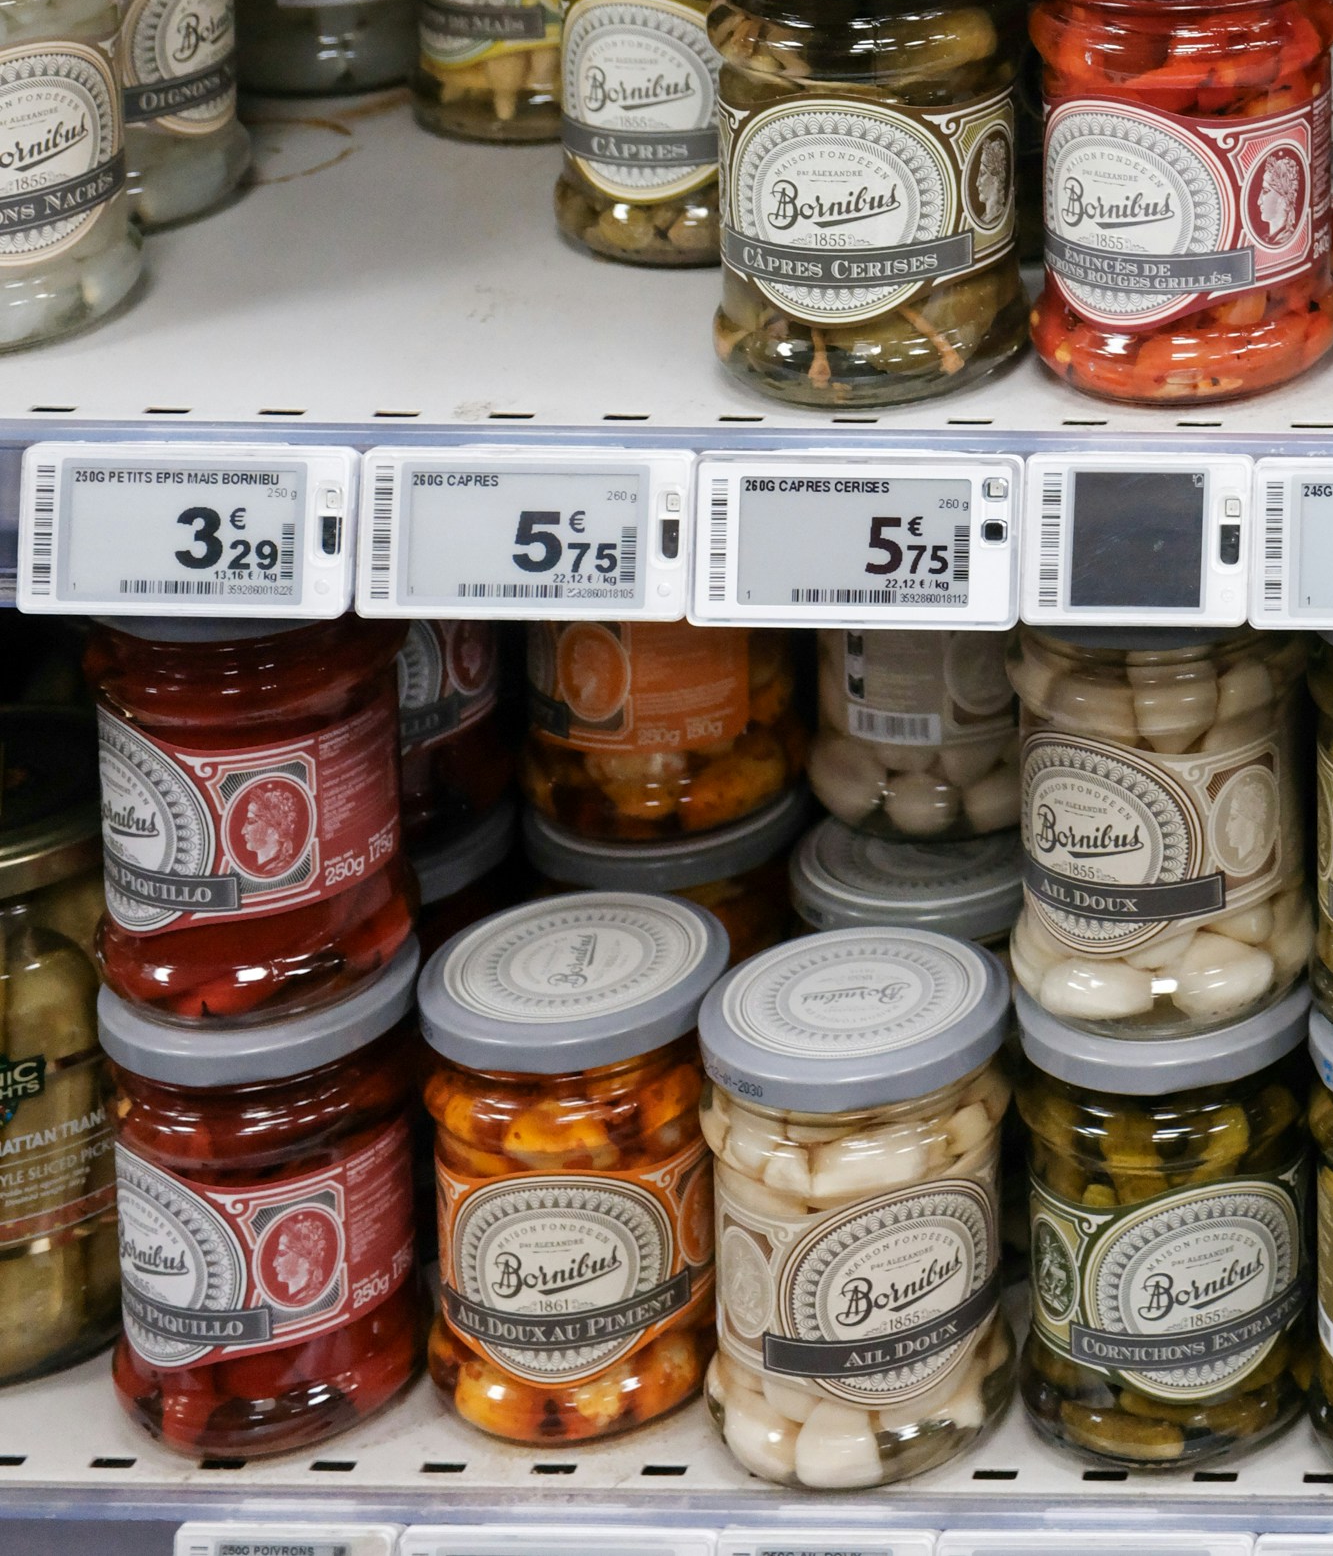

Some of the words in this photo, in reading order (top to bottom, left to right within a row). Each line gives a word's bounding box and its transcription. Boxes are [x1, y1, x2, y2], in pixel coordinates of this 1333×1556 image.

[743, 246, 823, 279] CÂPRES
[830, 251, 938, 278] CERISES
[75, 472, 105, 485] 250G
[109, 472, 150, 485] PETITS
[154, 472, 183, 485] EPIS
[188, 472, 219, 485] MAIS
[223, 472, 279, 486] BORNIBU
[413, 474, 444, 488] 260G
[448, 474, 499, 488] CAPRES
[324, 856, 365, 886] 250g
[456, 1307, 484, 1325] AIL
[487, 1318, 545, 1341] DOUX
[548, 1323, 580, 1341] AU
[587, 1292, 678, 1338] PIMENT
